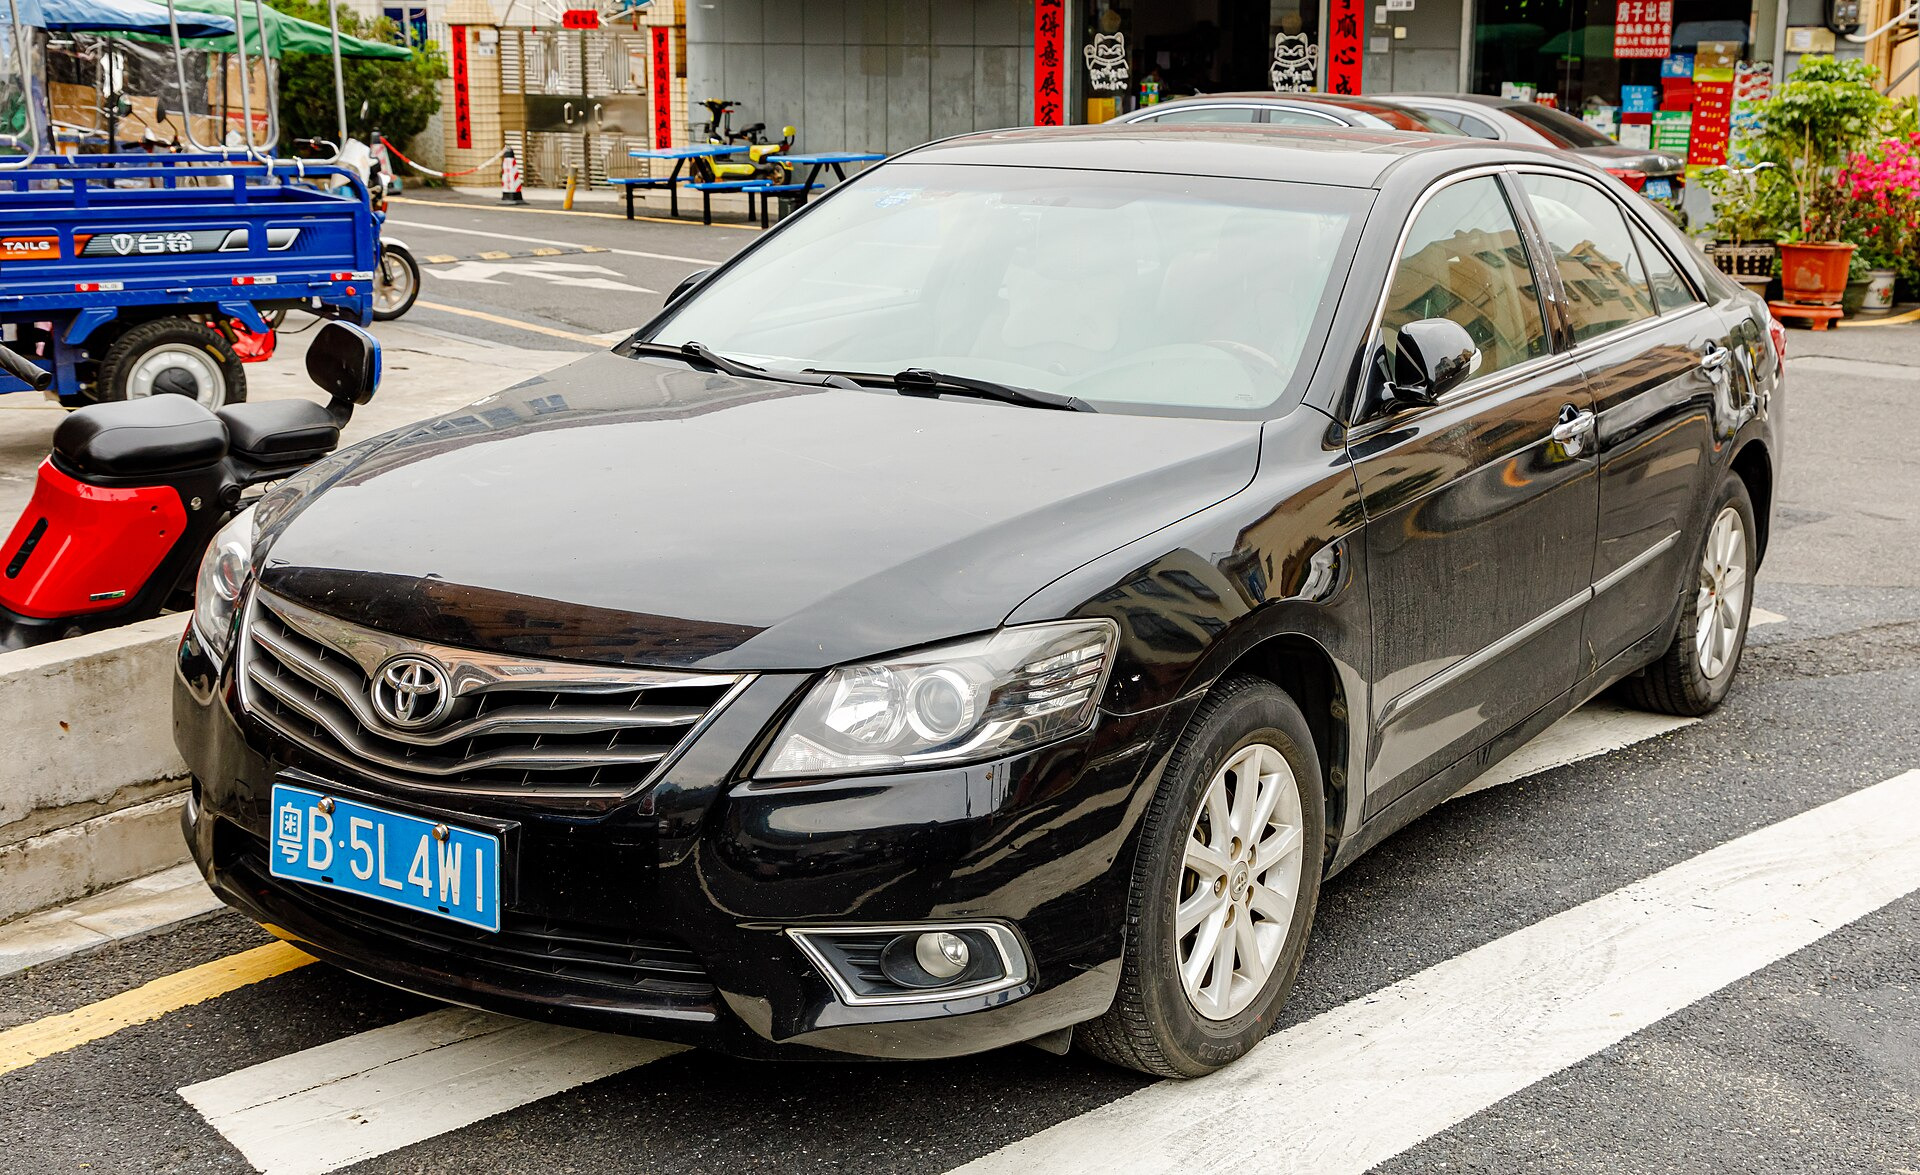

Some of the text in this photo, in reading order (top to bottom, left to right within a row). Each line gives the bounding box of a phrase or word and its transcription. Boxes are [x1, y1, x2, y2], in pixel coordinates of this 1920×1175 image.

[1616, 1, 1672, 22] 房子出租
[3, 240, 50, 252] TAILG
[138, 232, 194, 253] 台铃
